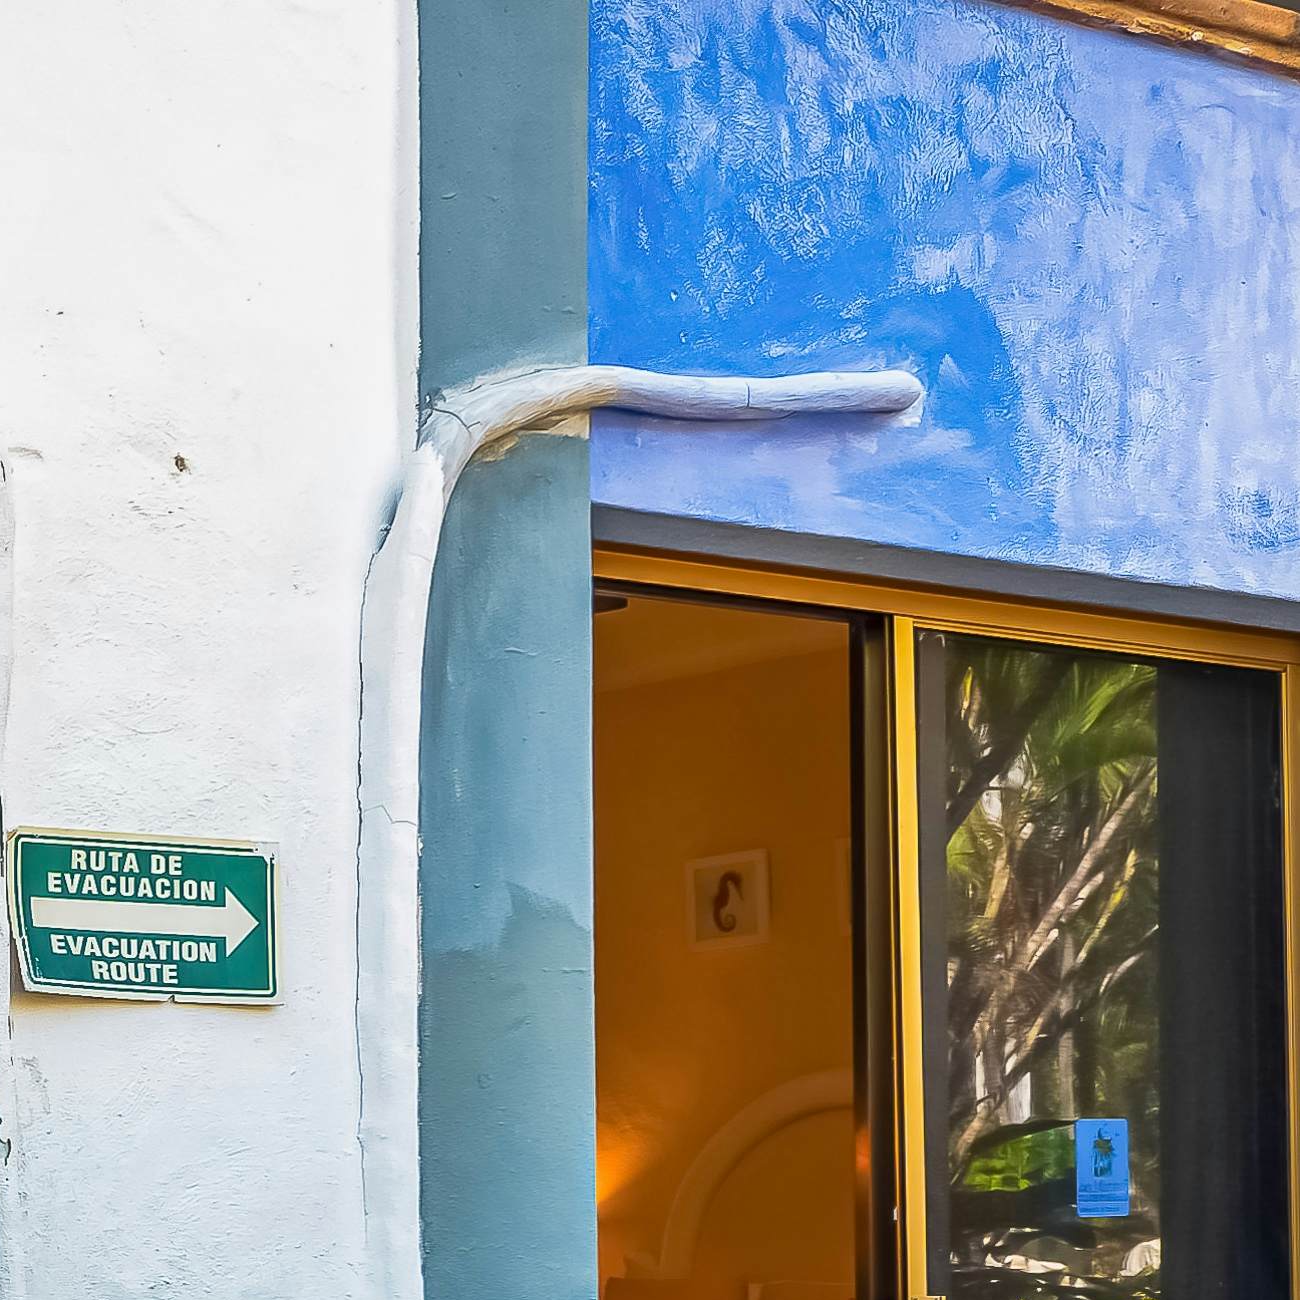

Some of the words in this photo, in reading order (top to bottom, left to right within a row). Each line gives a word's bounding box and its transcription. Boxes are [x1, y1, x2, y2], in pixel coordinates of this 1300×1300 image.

[71, 849, 140, 874] RUTA
[150, 854, 183, 876] DE
[47, 872, 216, 901] EVACUACION
[50, 933, 217, 962] EVACUATION
[92, 960, 179, 984] ROUTE
